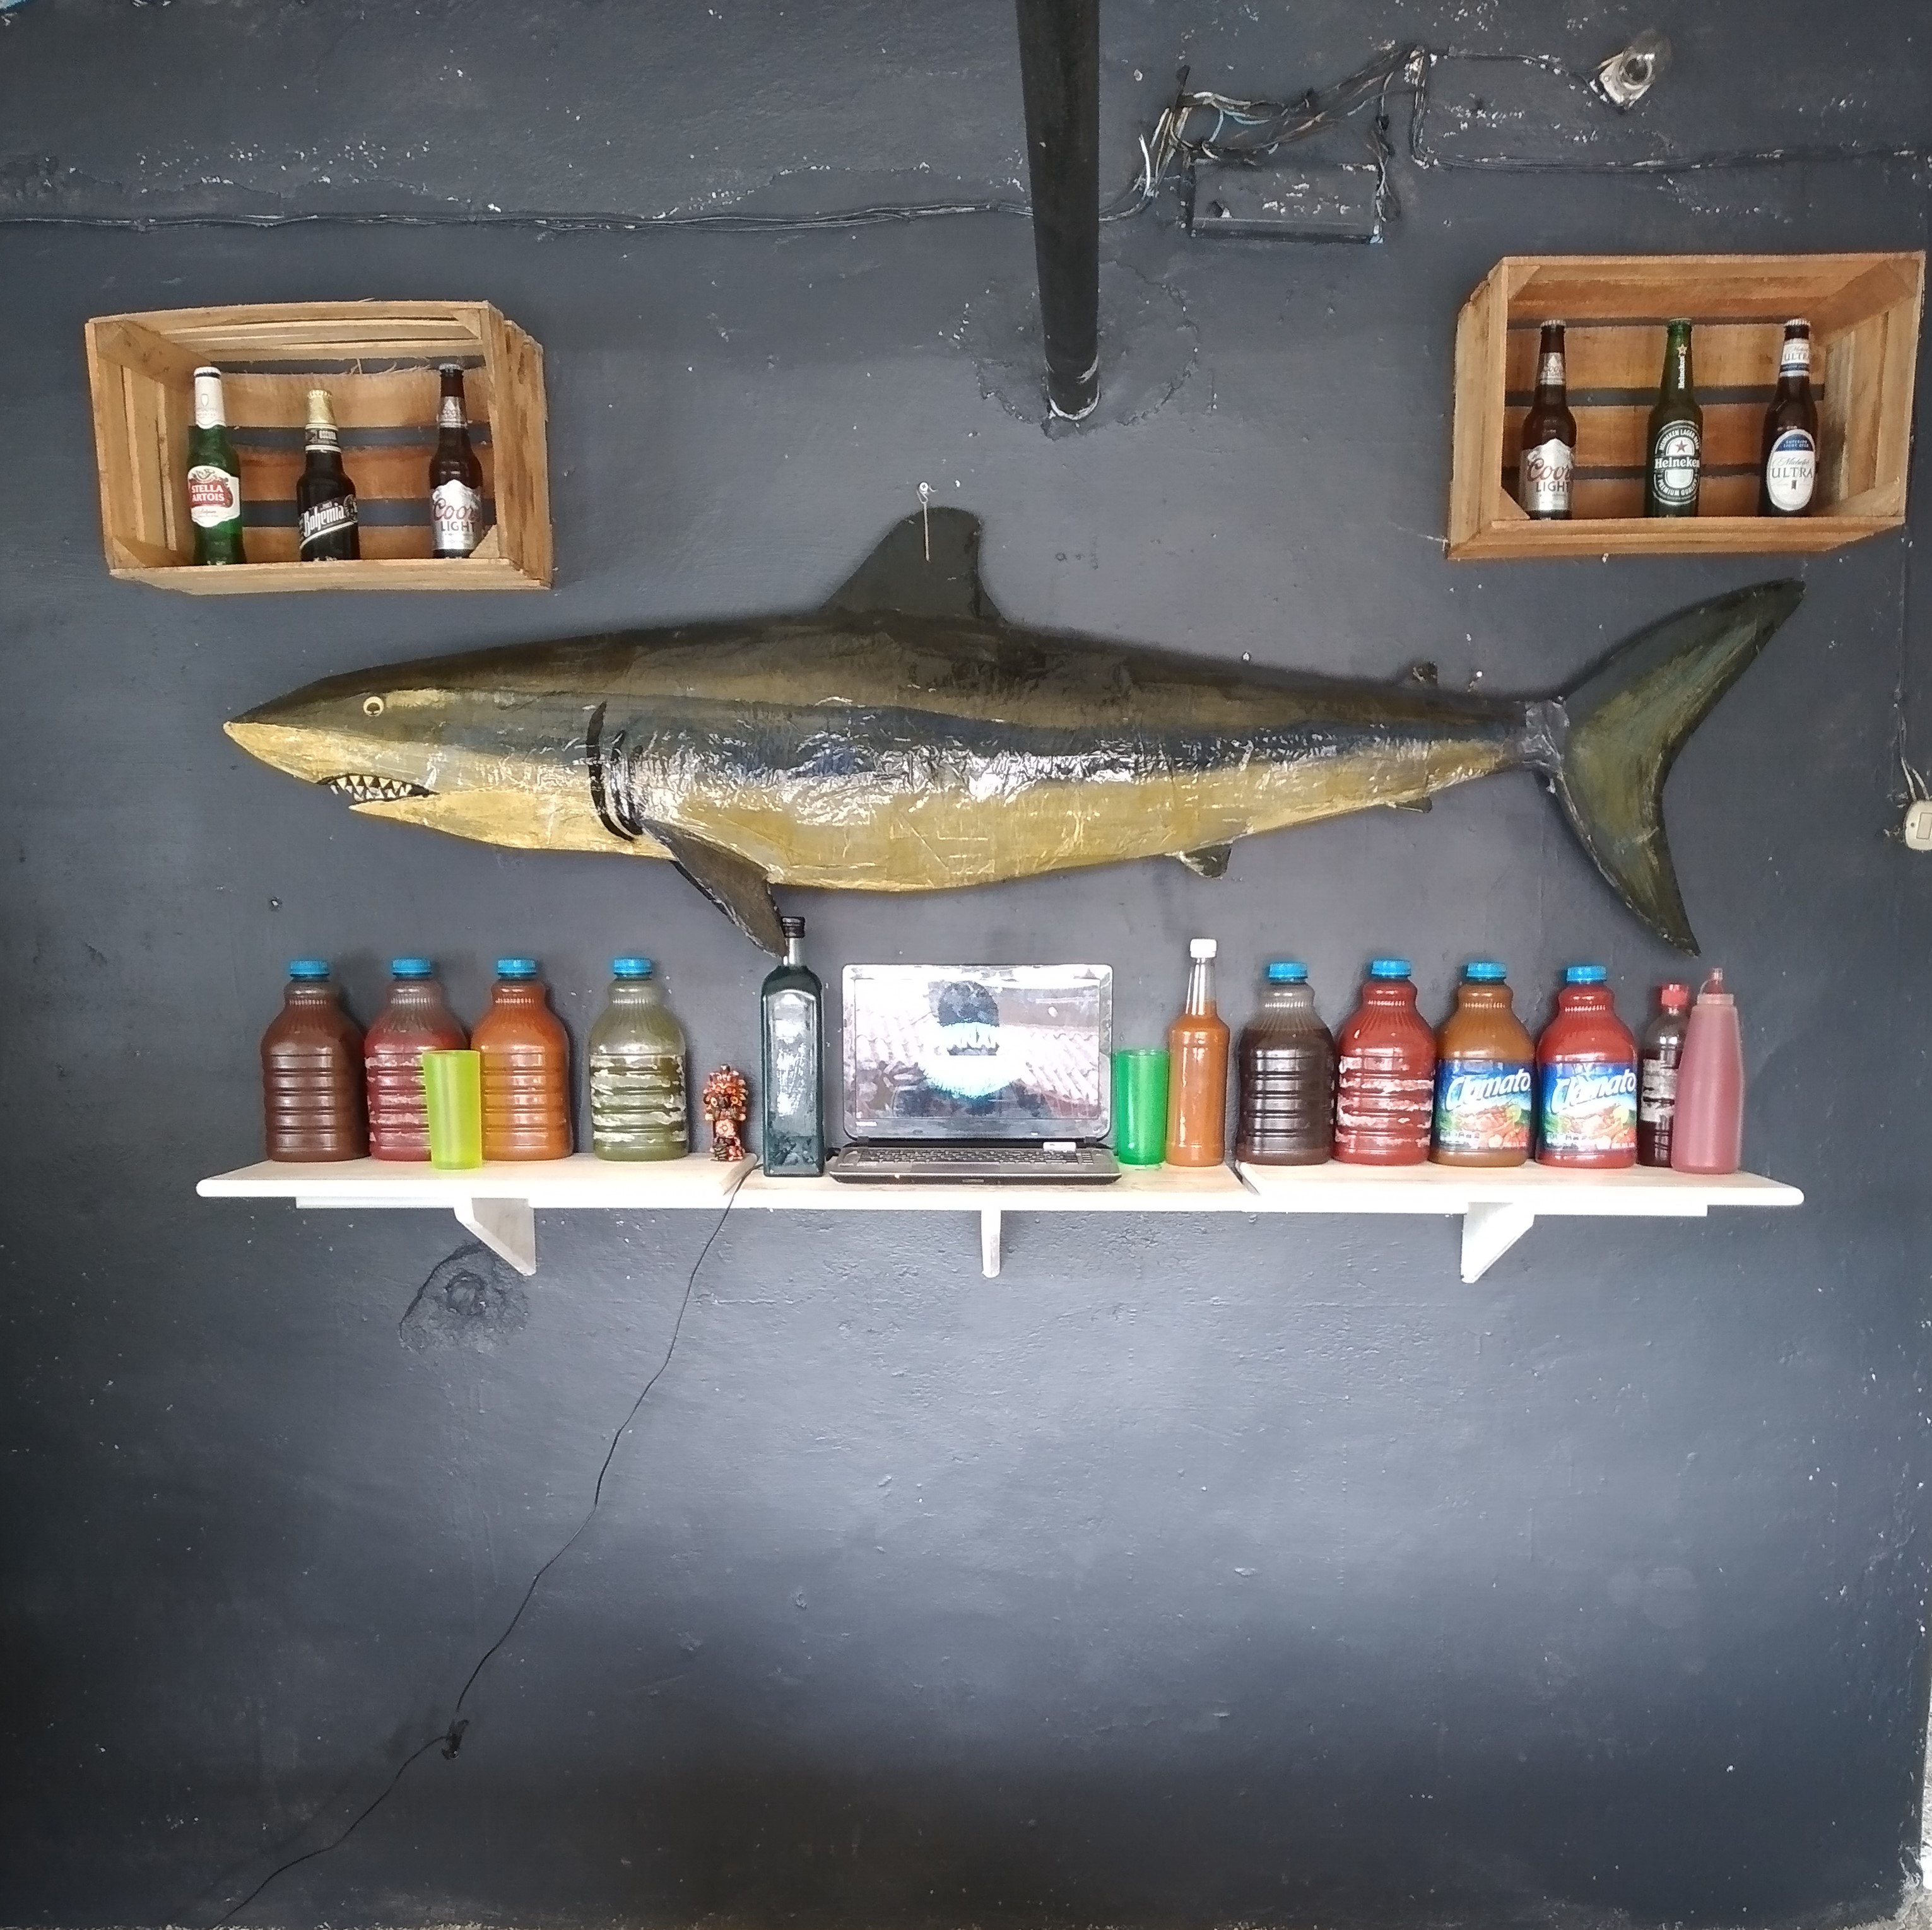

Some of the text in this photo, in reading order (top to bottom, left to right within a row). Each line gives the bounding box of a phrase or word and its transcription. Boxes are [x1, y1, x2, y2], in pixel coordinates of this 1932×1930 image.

[1654, 457, 1700, 469] Heineken
[1772, 467, 1813, 478] ULTRA
[191, 484, 224, 493] STELLA
[1536, 481, 1570, 492] LIGHT
[1658, 479, 1680, 496] PREMIUM
[191, 493, 225, 502] ARTOIS
[303, 502, 345, 538] Bohemia
[440, 521, 475, 532] LIGHT
[1446, 1068, 1531, 1112] Clamato
[1550, 1069, 1637, 1115] Clamato
